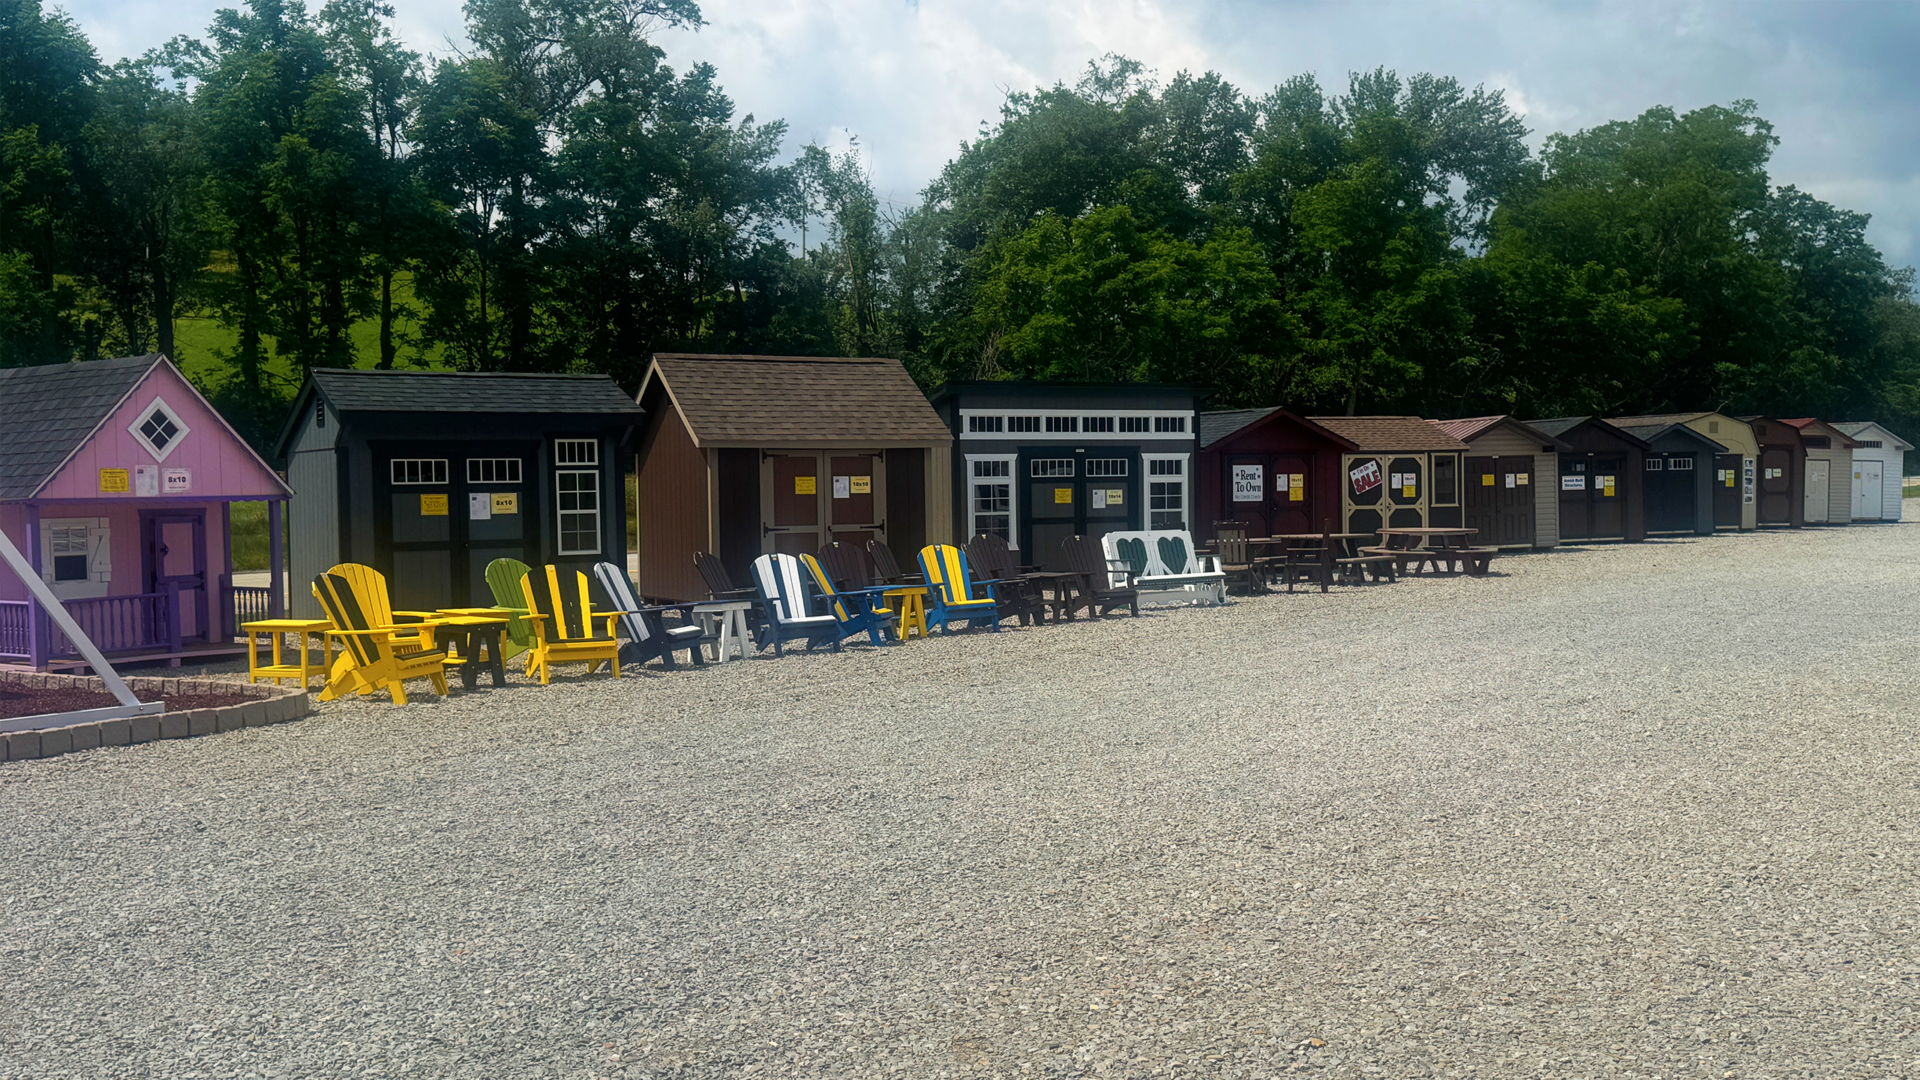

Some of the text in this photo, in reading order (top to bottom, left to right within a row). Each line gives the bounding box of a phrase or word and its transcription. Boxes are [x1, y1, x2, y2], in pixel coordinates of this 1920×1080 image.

[1240, 470, 1256, 480] Rent
[1235, 481, 1262, 492] To Own
[1354, 470, 1380, 493] SALE
